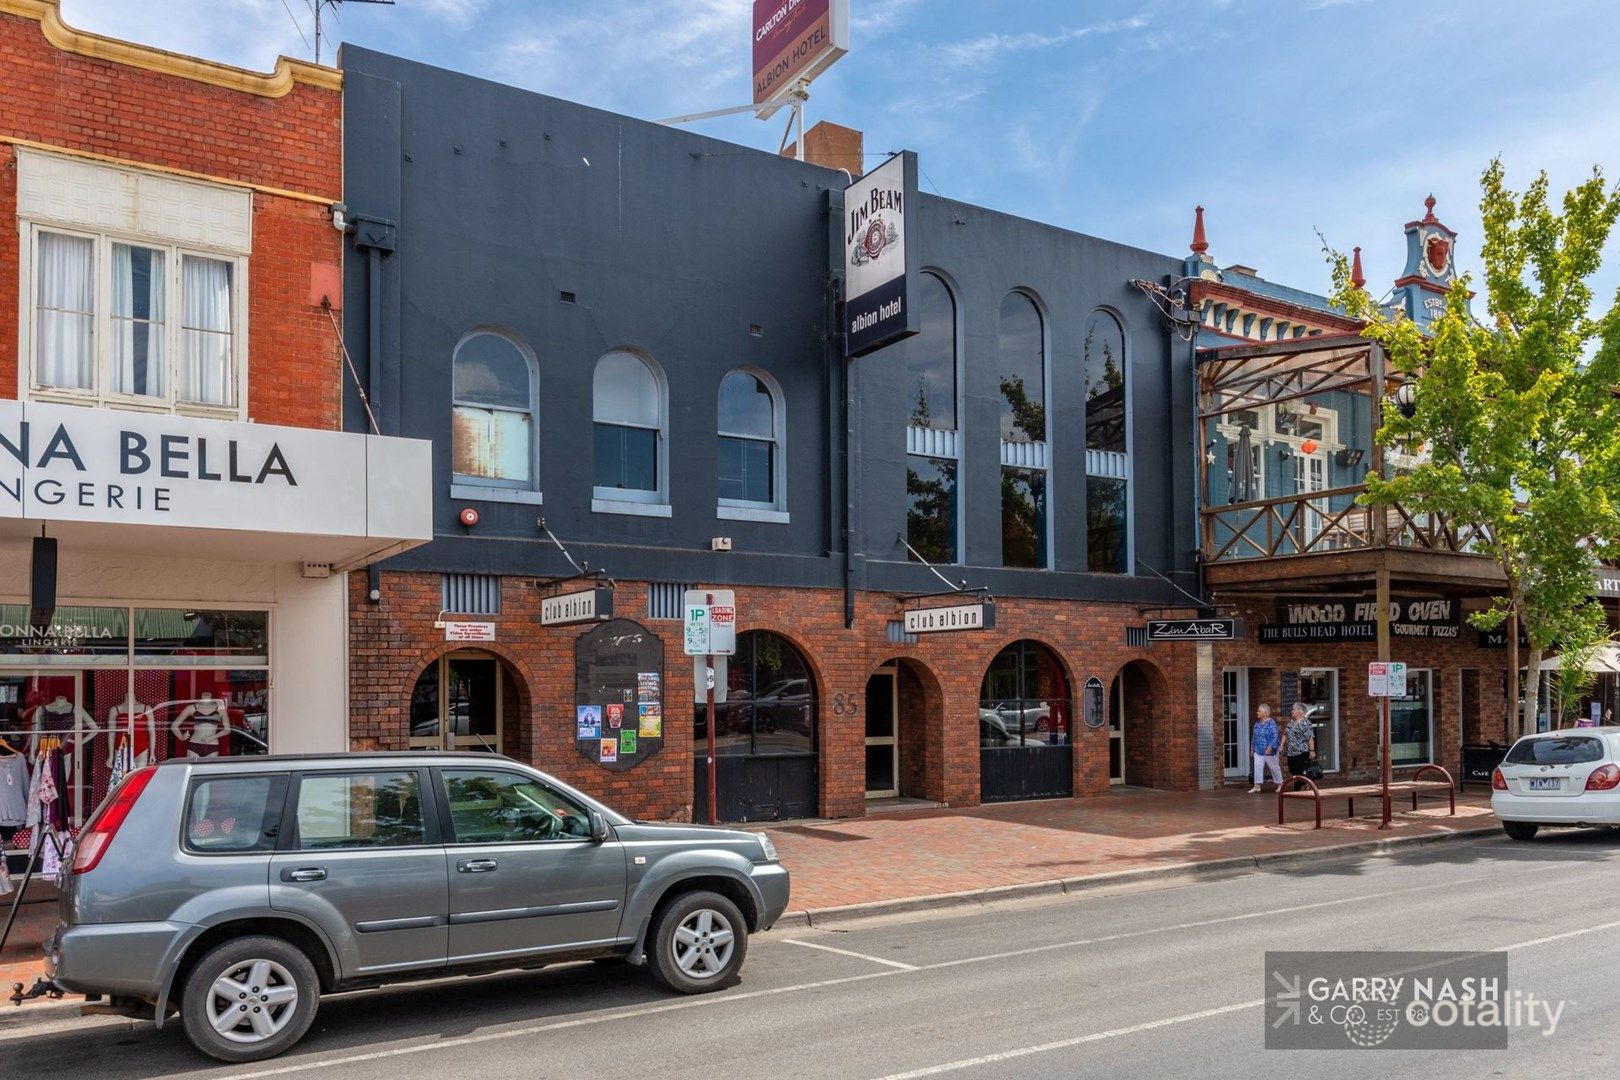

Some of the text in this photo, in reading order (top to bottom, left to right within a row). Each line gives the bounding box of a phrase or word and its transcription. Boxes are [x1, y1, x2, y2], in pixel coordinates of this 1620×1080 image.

[756, 4, 788, 41] CARLTON
[756, 26, 826, 96] ALBION HOTEL
[848, 188, 903, 245] JIM BEAM
[851, 296, 902, 334] albion hotel
[119, 430, 299, 486] BELLA
[545, 597, 592, 620] club albion
[690, 609, 705, 621] 1P
[712, 614, 734, 622] ZONE
[910, 610, 977, 629] club albion
[1288, 600, 1451, 624] WOOD FIRD OVEN
[1263, 624, 1374, 638] THE BULLS HEAD HOTEL
[1393, 664, 1403, 673] 1P
[833, 693, 858, 716] 85
